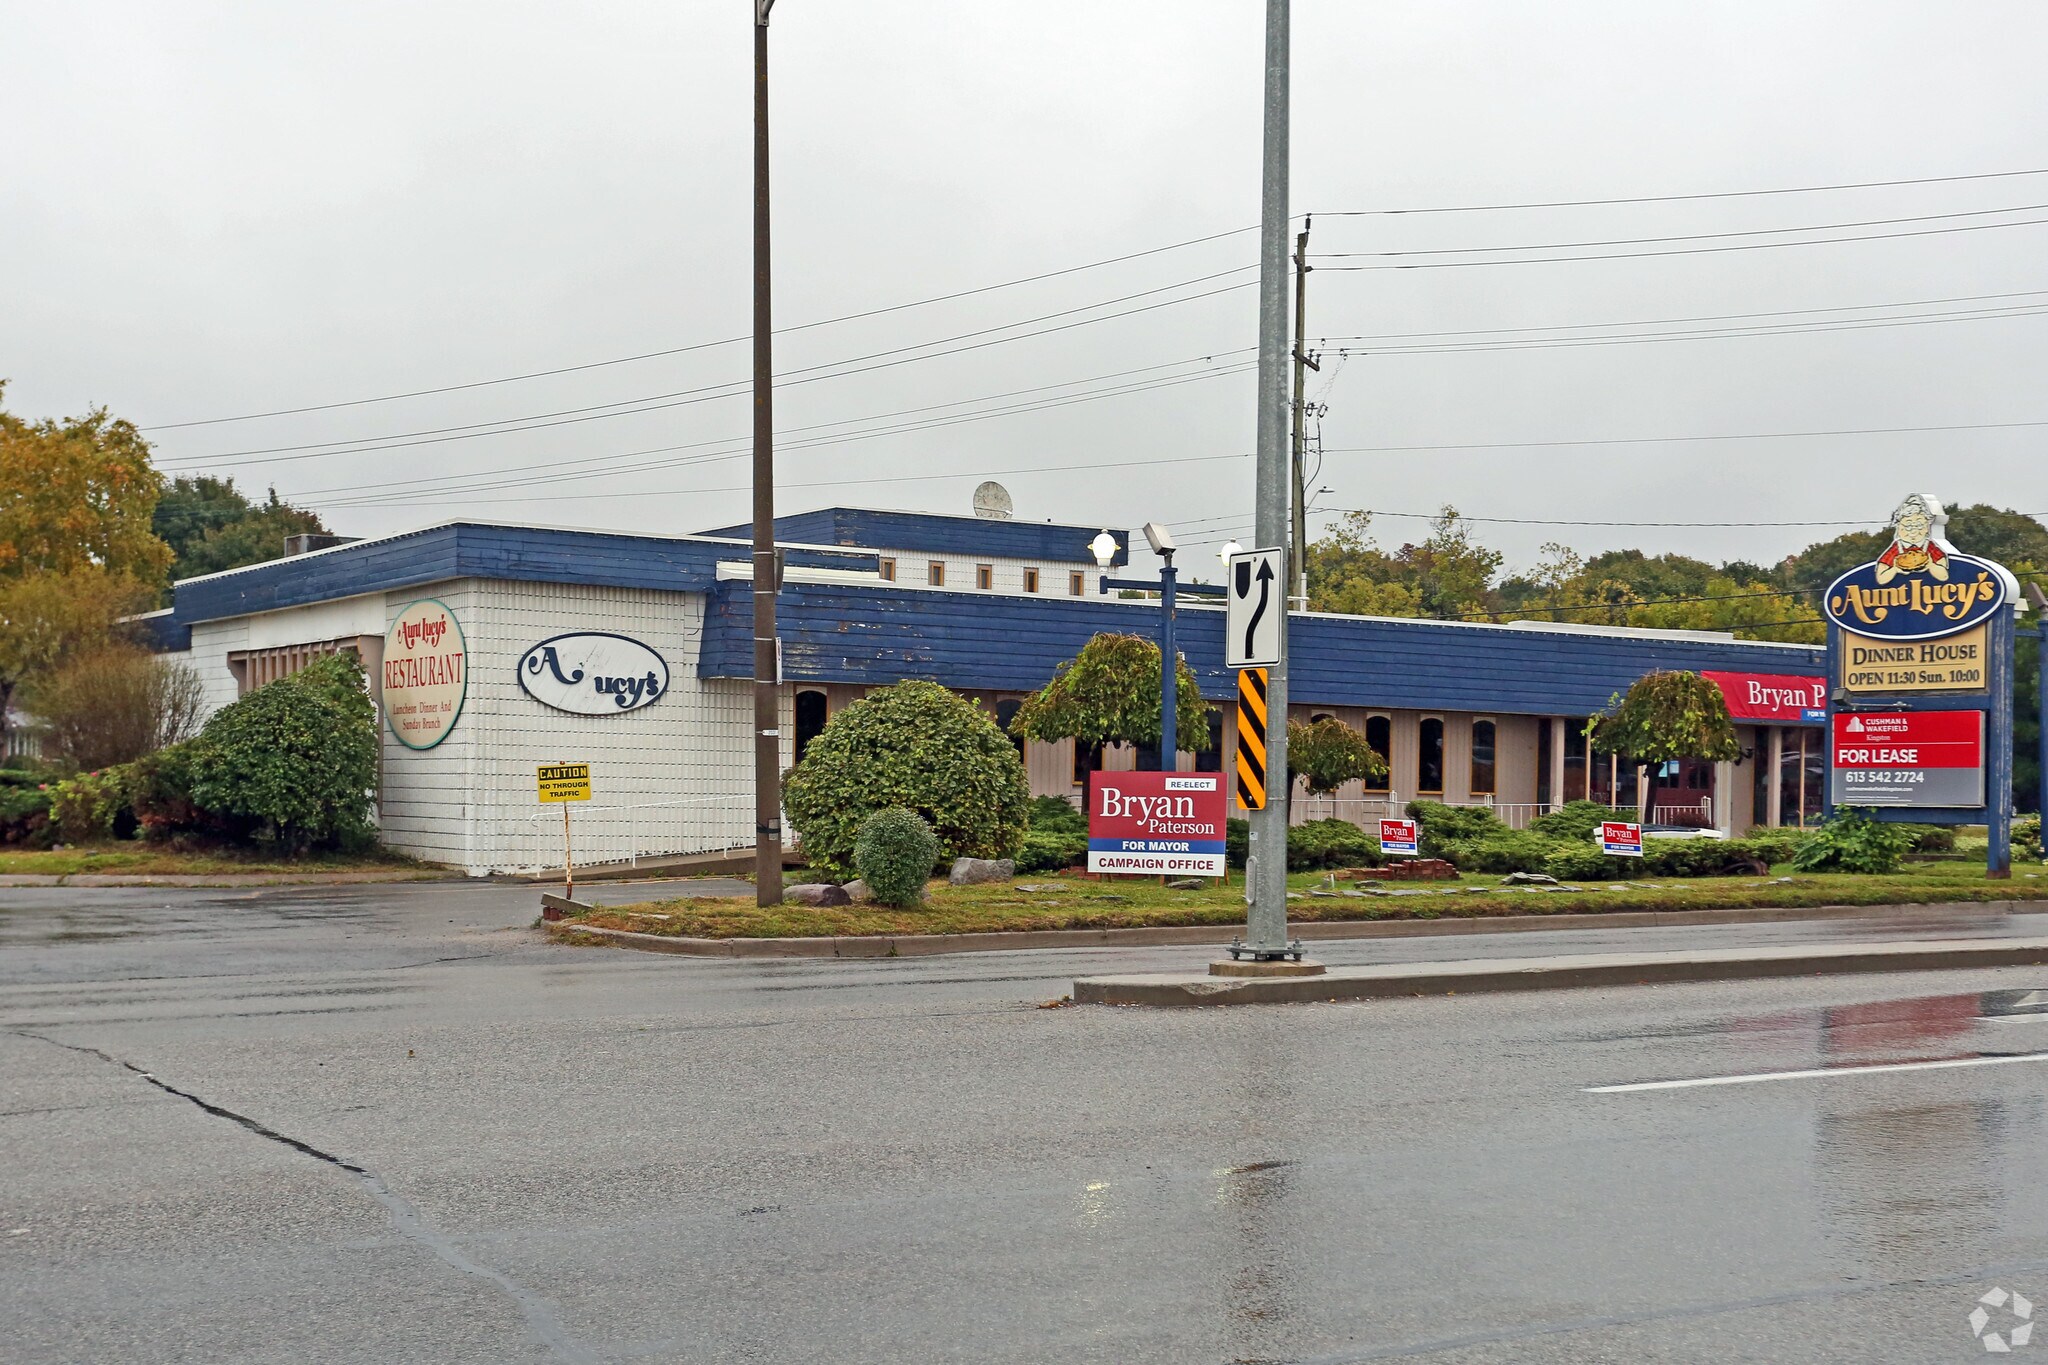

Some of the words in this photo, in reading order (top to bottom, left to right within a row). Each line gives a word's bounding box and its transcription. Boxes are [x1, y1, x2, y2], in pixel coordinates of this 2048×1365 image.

[1831, 583, 1910, 624] Aunt
[1910, 571, 1995, 620] Lucy's
[398, 621, 422, 650] Aunt
[422, 614, 447, 648] Lucy's
[1853, 647, 1915, 665] DINNER
[1920, 645, 1977, 663] HOUSE
[385, 653, 463, 689] RESTAURANT
[528, 647, 584, 684] A
[1849, 672, 1884, 686] OPEN
[1887, 671, 1916, 684] 11:30
[1919, 670, 1946, 683] Sun.
[1949, 669, 1980, 682] 10:00
[1747, 681, 1808, 712] Bryan
[393, 704, 417, 715] Luncheon
[419, 702, 438, 713] Dinner
[440, 700, 452, 712] And
[402, 719, 421, 733] Sunday
[422, 717, 441, 729] Brunch
[1838, 749, 1869, 763] FOR
[1872, 749, 1918, 763] LEASE
[540, 768, 587, 779] CAUTION
[1845, 771, 1866, 782] 613
[1868, 771, 1891, 782] 542
[1894, 771, 1924, 782] 2724
[553, 781, 588, 789] THROUGH
[1170, 781, 1211, 789] RE-ELECT
[550, 790, 580, 798] TRAFFIC
[1099, 787, 1195, 826] Bryan
[1148, 818, 1215, 835] Paterson
[1383, 825, 1408, 838] Bryan
[1606, 827, 1632, 840] Bryan
[1122, 841, 1146, 850] FOR
[1149, 842, 1190, 852] MAYOR
[1098, 857, 1164, 869] CAMPAIGN
[1168, 860, 1214, 870] OFFICE
